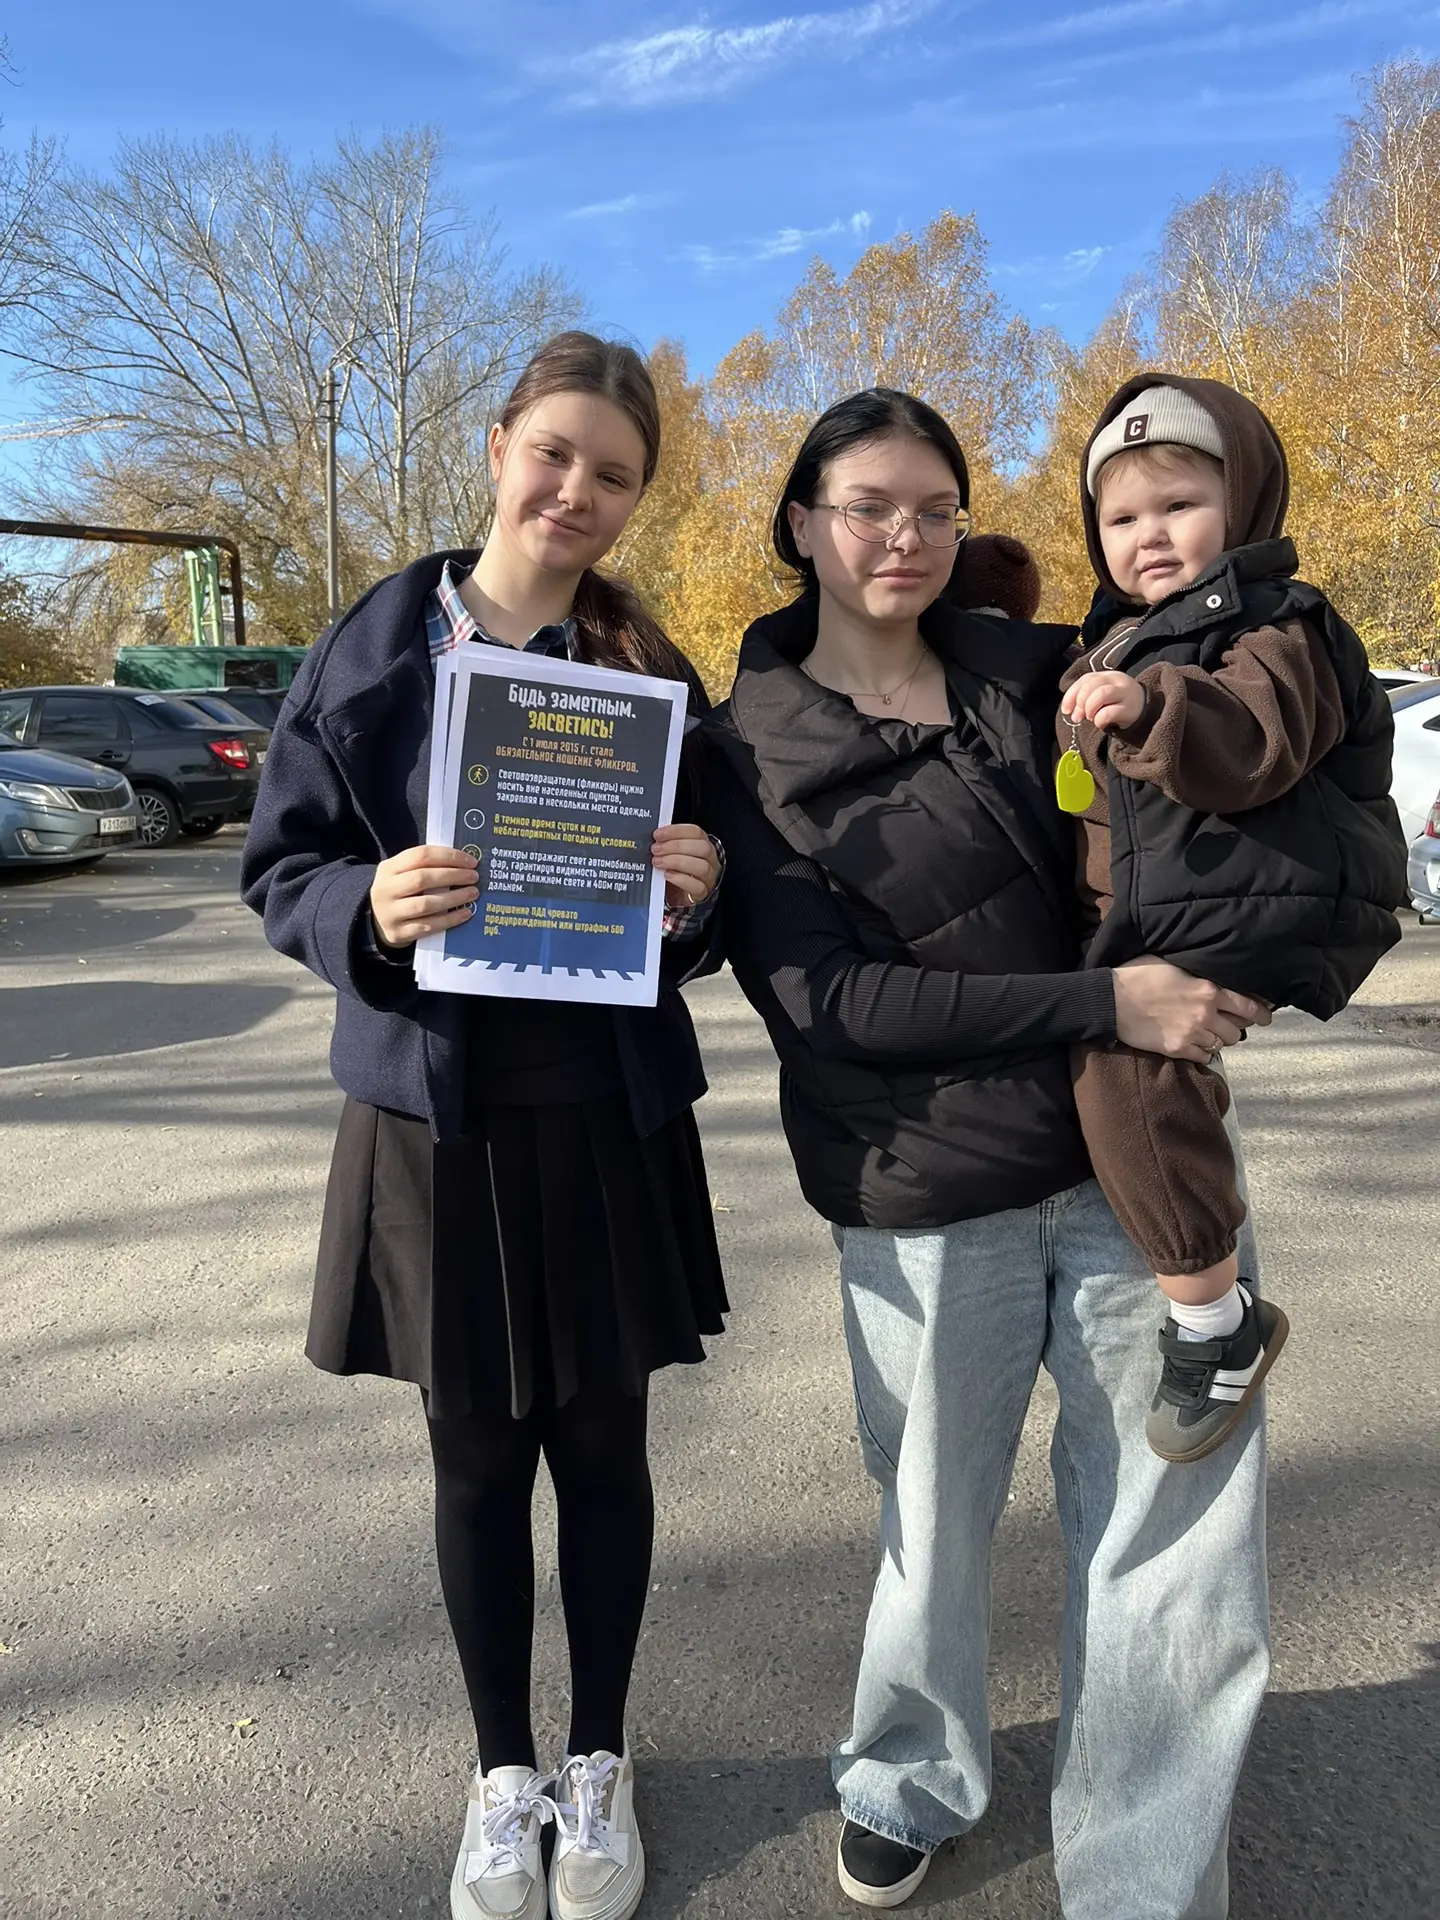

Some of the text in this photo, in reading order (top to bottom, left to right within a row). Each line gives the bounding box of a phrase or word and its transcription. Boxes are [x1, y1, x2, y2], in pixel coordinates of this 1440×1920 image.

[508, 683, 637, 719] Будь заметным.
[528, 710, 614, 739] ЗАСВЕТИСЬ!
[530, 738, 534, 748] 1
[536, 739, 558, 750] июля
[560, 742, 579, 753] 2015
[581, 745, 588, 754] г.
[590, 746, 614, 757] стало
[496, 746, 639, 772] ОБЯЗАТЕЛЬНОЕ НОШЕНИЕ ФЛИКЕРОВ.
[498, 769, 644, 794] Световозвращатели (фликеры) нужно
[497, 782, 622, 804] носить вне населенных пунктов,
[496, 792, 652, 818] закрепляя в нескольких местах одежды.
[494, 814, 500, 823] В
[502, 816, 530, 826] темное
[532, 819, 556, 828] время
[558, 822, 579, 832] суток
[587, 825, 602, 834] при
[494, 826, 637, 849] неблагоприятных погодных условиях.
[490, 858, 644, 882] фар, гарантируя видимость пешехода за
[492, 847, 646, 871] Фликеры отражают свет автомобильных
[488, 882, 524, 892] дальнем.
[490, 870, 508, 880] 150м
[510, 872, 524, 882] при
[526, 873, 562, 885] ближнем
[564, 878, 585, 887] свете
[593, 880, 612, 890] 400м
[614, 882, 628, 892] при
[486, 902, 578, 920] Нарушение ПДД чревато
[484, 926, 501, 936] руб.
[485, 914, 558, 928] предупреждением
[558, 921, 574, 930] или
[574, 922, 610, 934] штрафом
